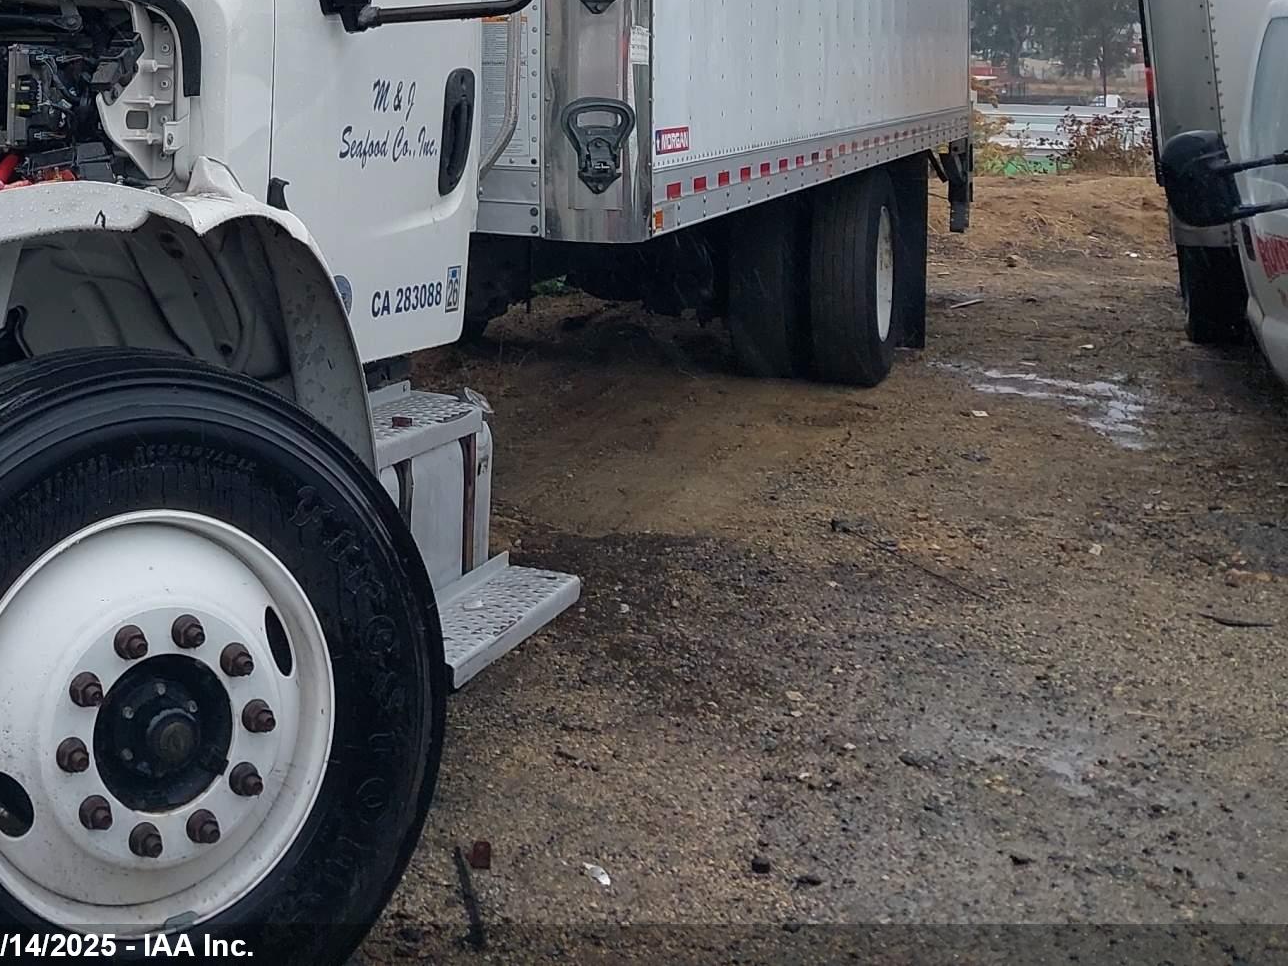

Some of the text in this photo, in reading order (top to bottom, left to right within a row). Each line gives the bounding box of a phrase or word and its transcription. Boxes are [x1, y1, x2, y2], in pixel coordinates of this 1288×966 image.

[372, 78, 416, 122] M & J
[339, 125, 389, 169] Seafood
[661, 132, 688, 150] MORGAN
[371, 281, 442, 317] CA 283088
